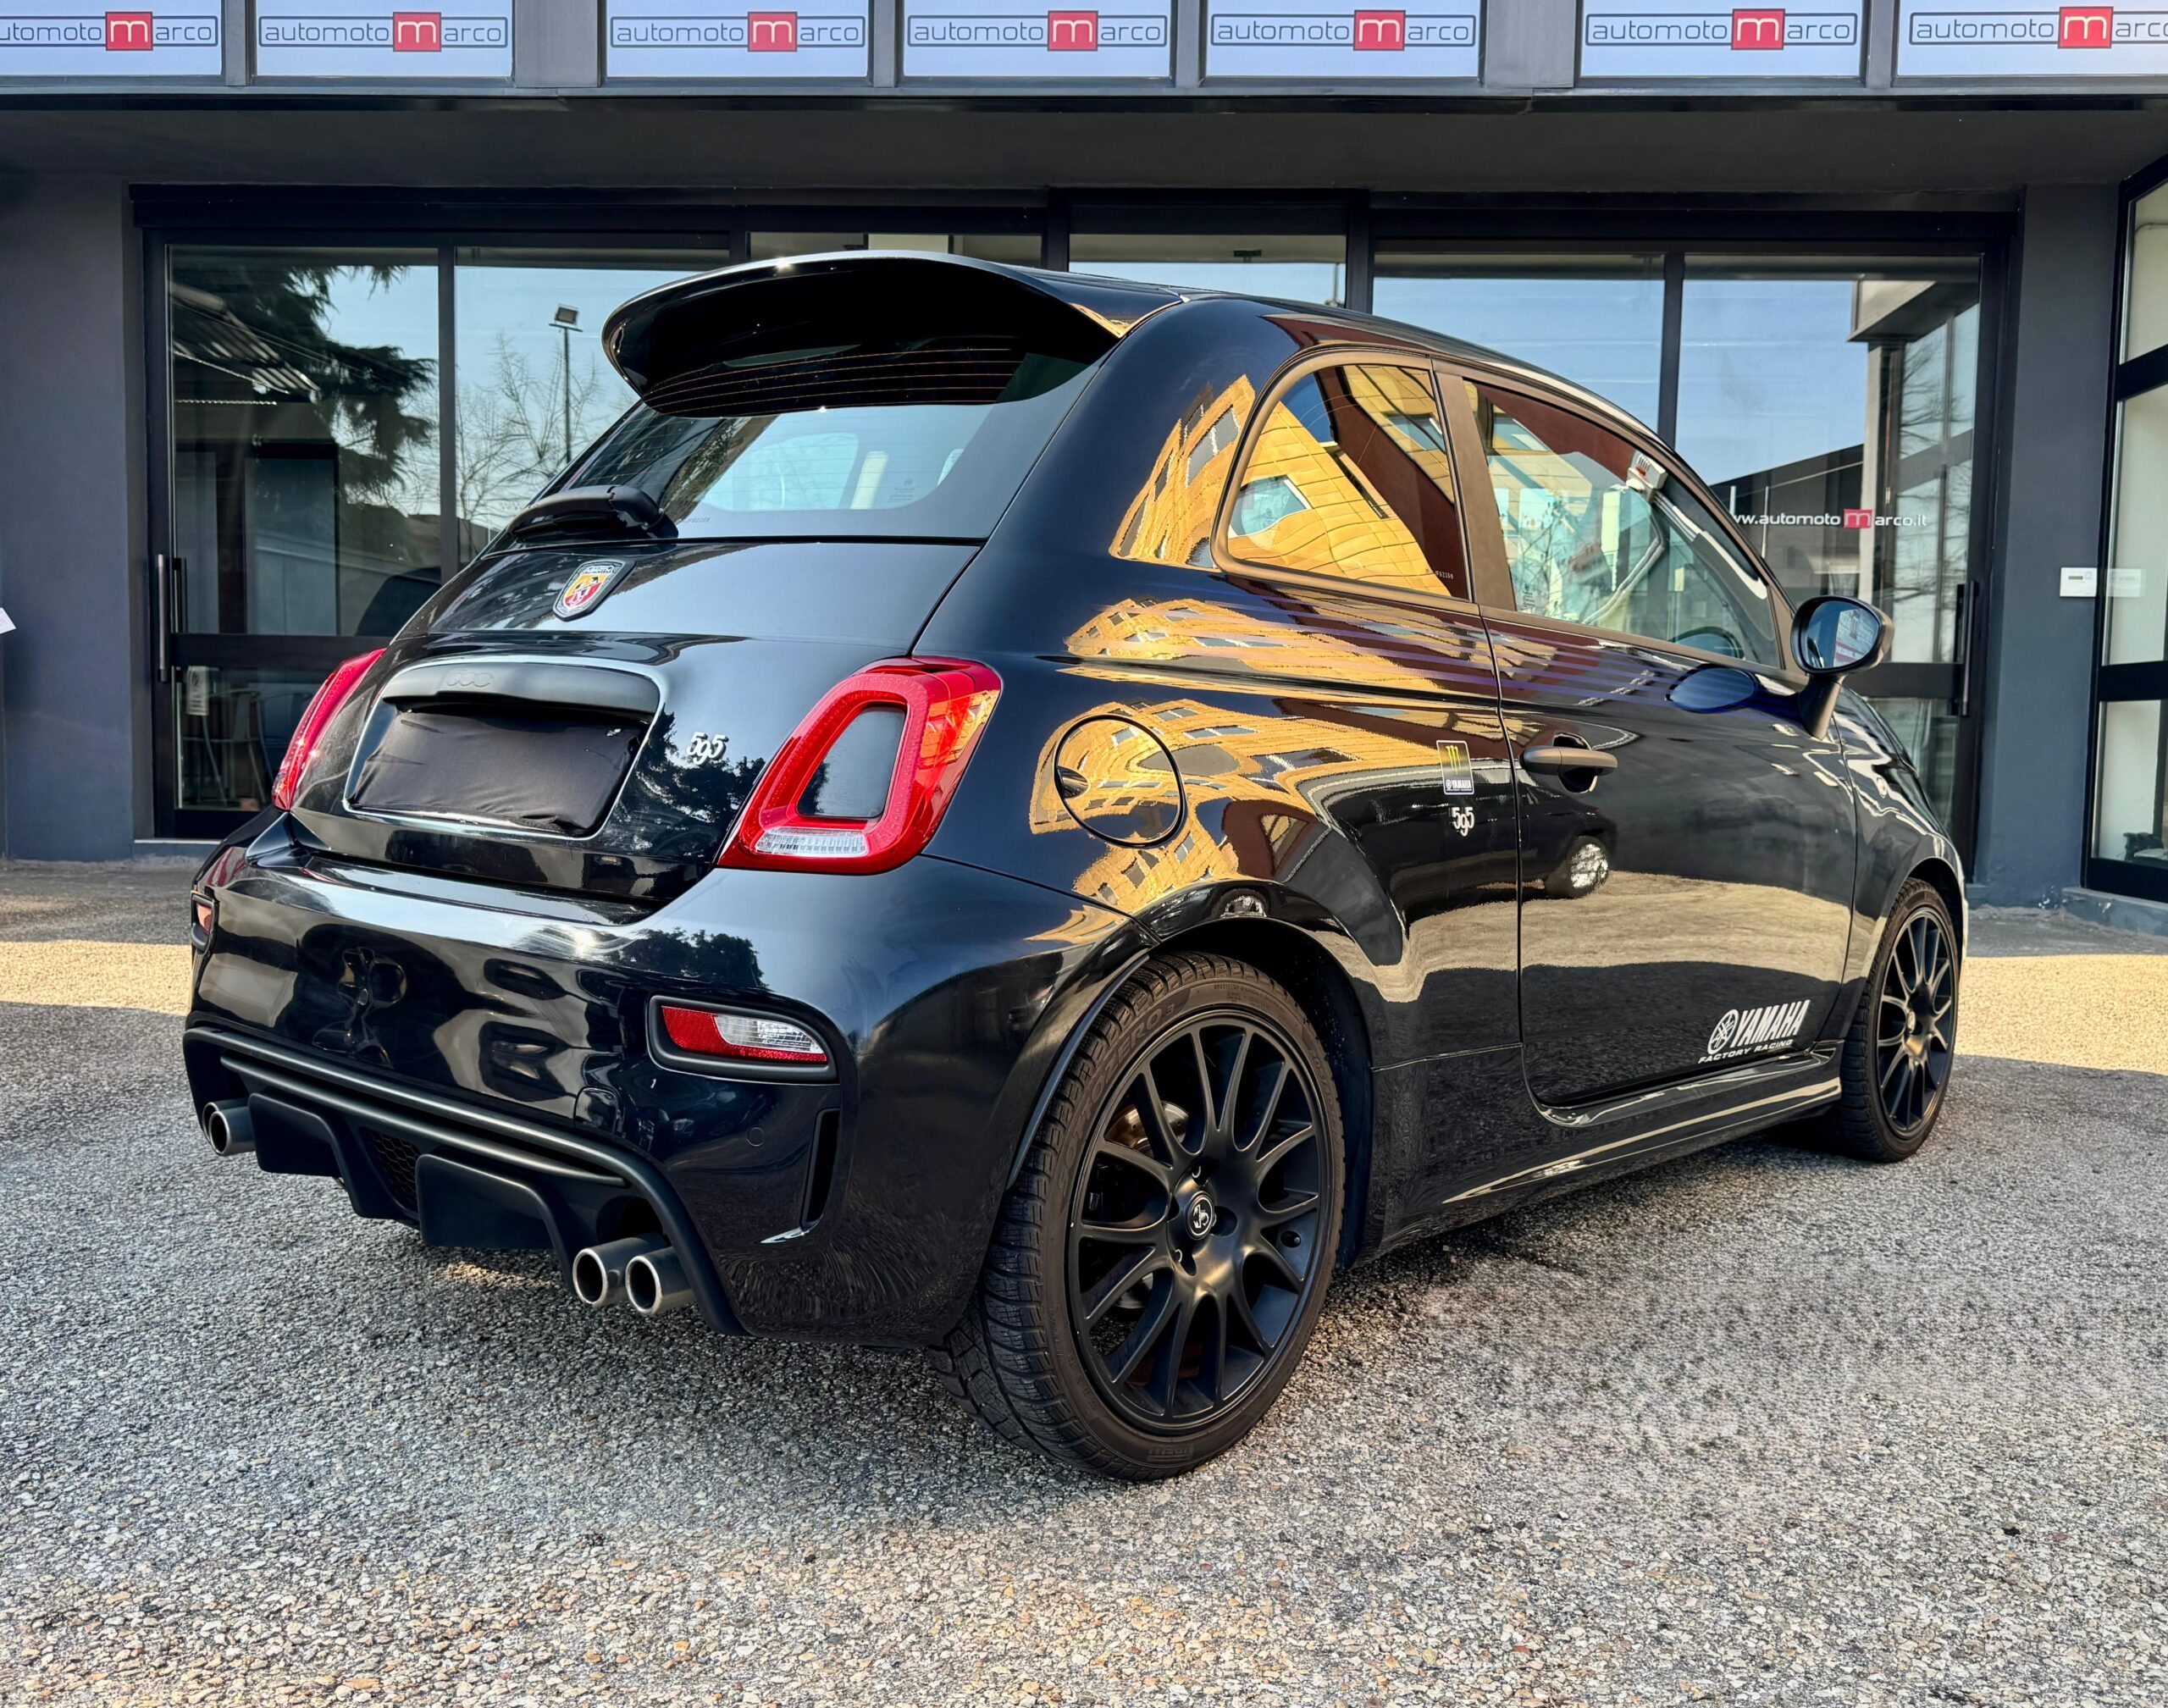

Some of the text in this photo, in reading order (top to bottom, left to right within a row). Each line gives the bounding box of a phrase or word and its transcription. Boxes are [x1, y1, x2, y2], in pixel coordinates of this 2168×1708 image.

[1451, 806, 1475, 837] 595
[1729, 999, 1811, 1048] YAMAHA
[1698, 1038, 1795, 1064] FACTORY RACING
